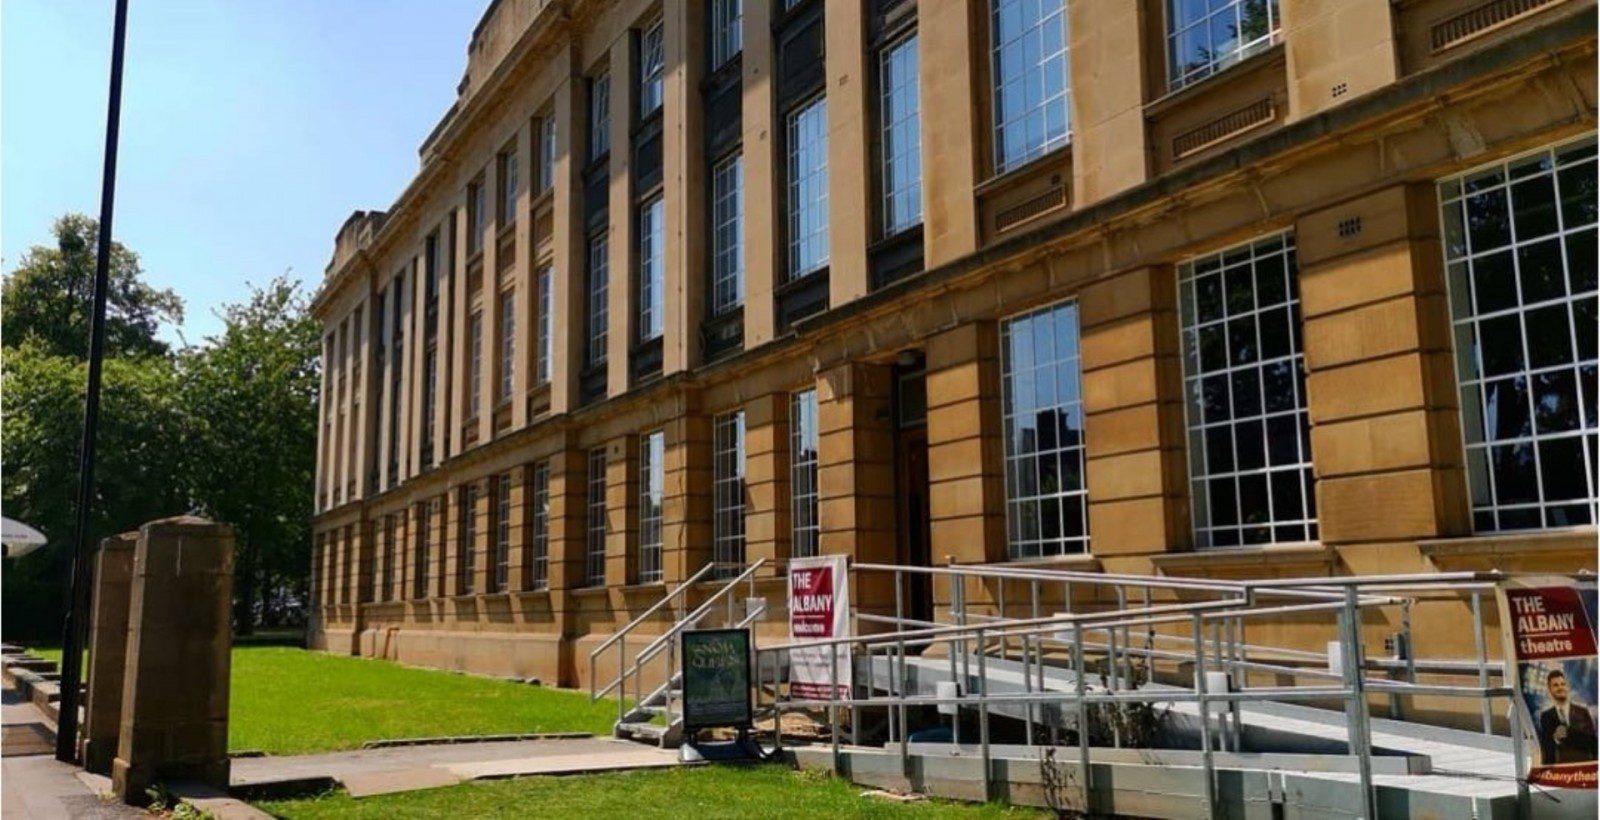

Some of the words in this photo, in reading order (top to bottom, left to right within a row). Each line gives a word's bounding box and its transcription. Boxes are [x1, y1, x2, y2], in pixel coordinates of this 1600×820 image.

[793, 572, 812, 590] THE
[792, 594, 832, 612] ALBANY
[1511, 596, 1546, 614] THE
[1518, 612, 1574, 633] ALBANY
[1520, 639, 1573, 654] theatre
